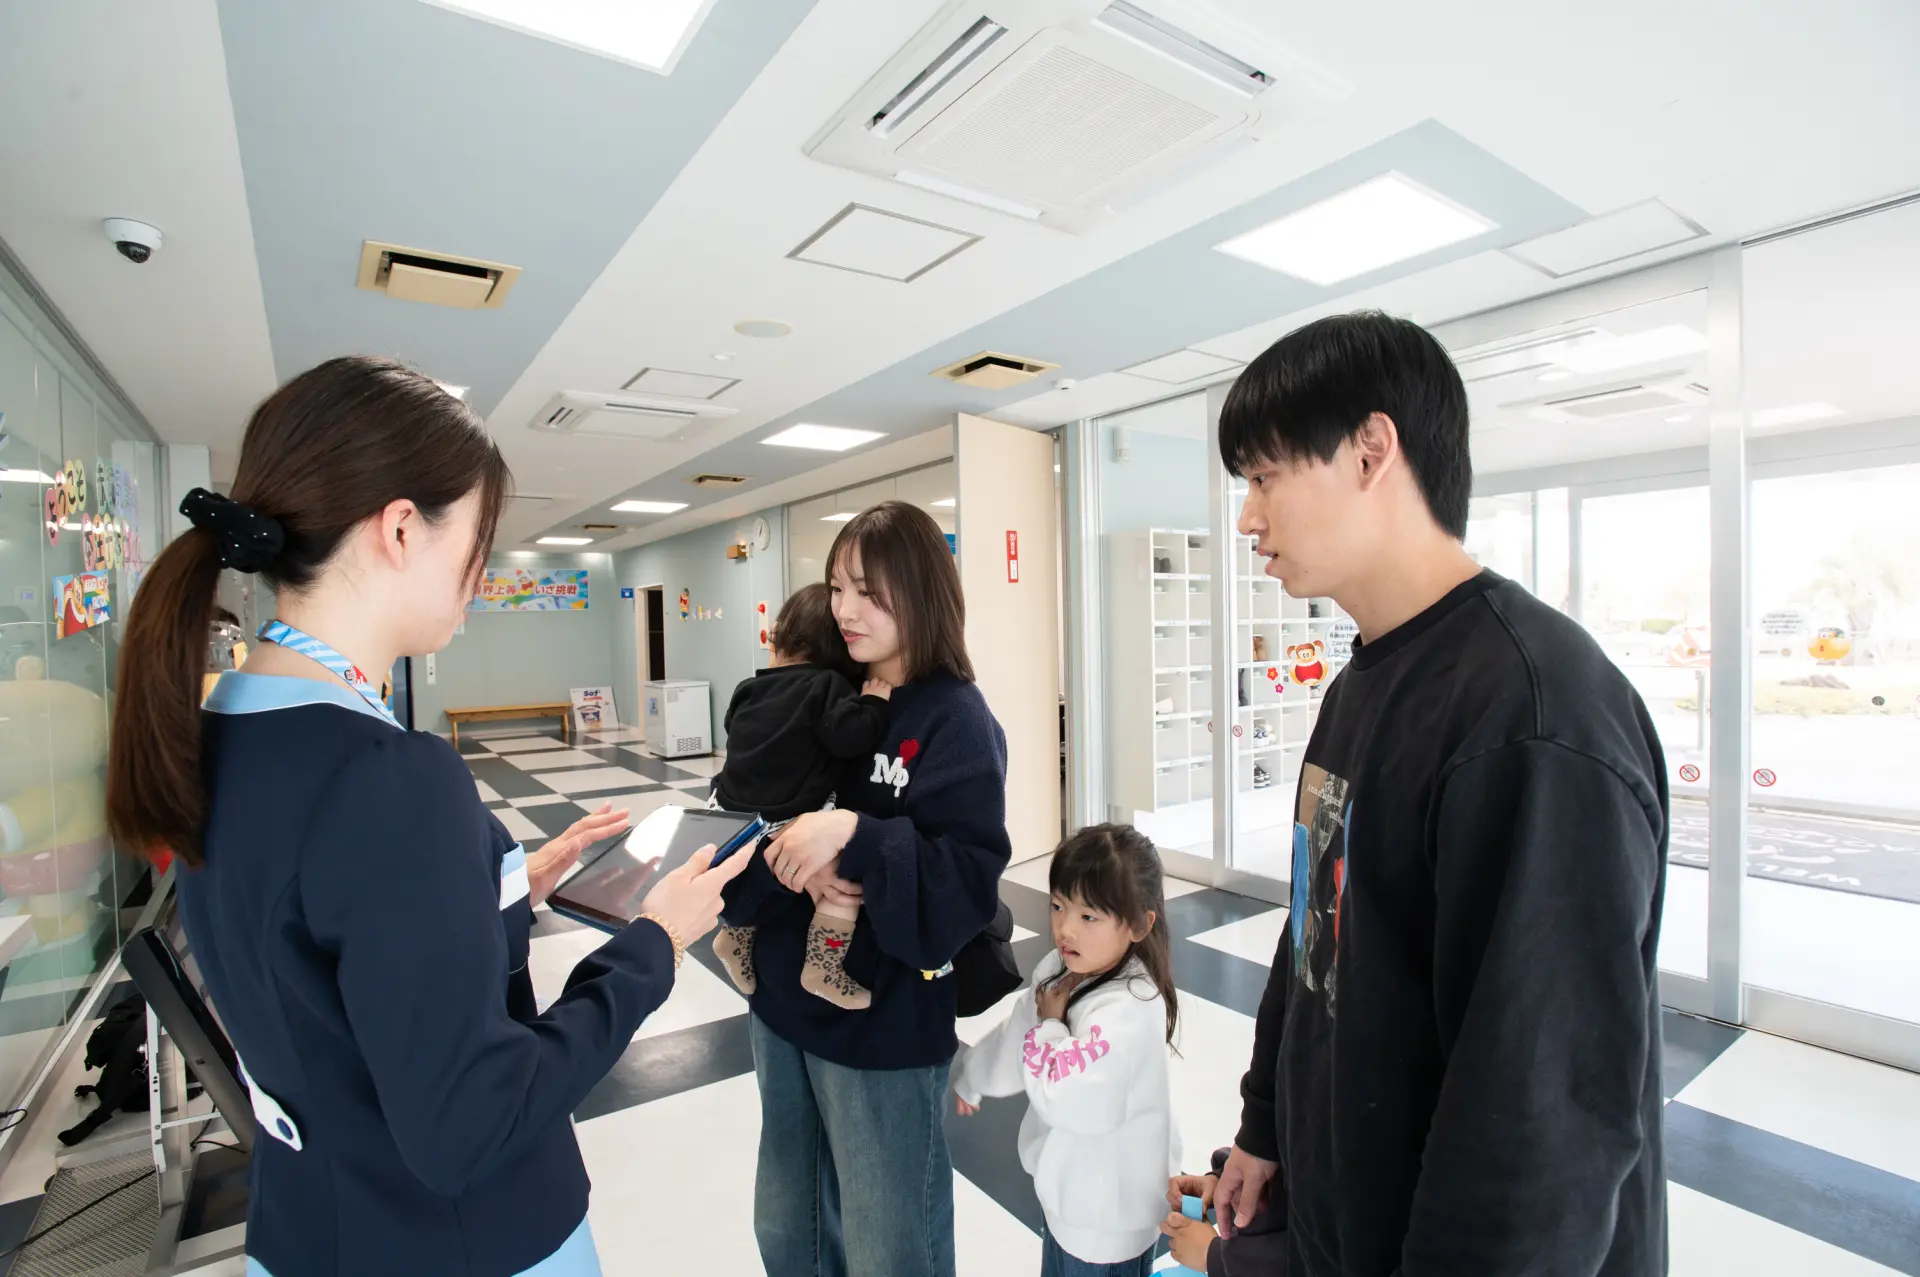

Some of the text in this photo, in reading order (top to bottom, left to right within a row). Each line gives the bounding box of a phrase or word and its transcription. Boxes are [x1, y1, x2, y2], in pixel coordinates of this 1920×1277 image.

[49, 467, 85, 538] ようこそ
[535, 585, 578, 595] いざ挑戦
